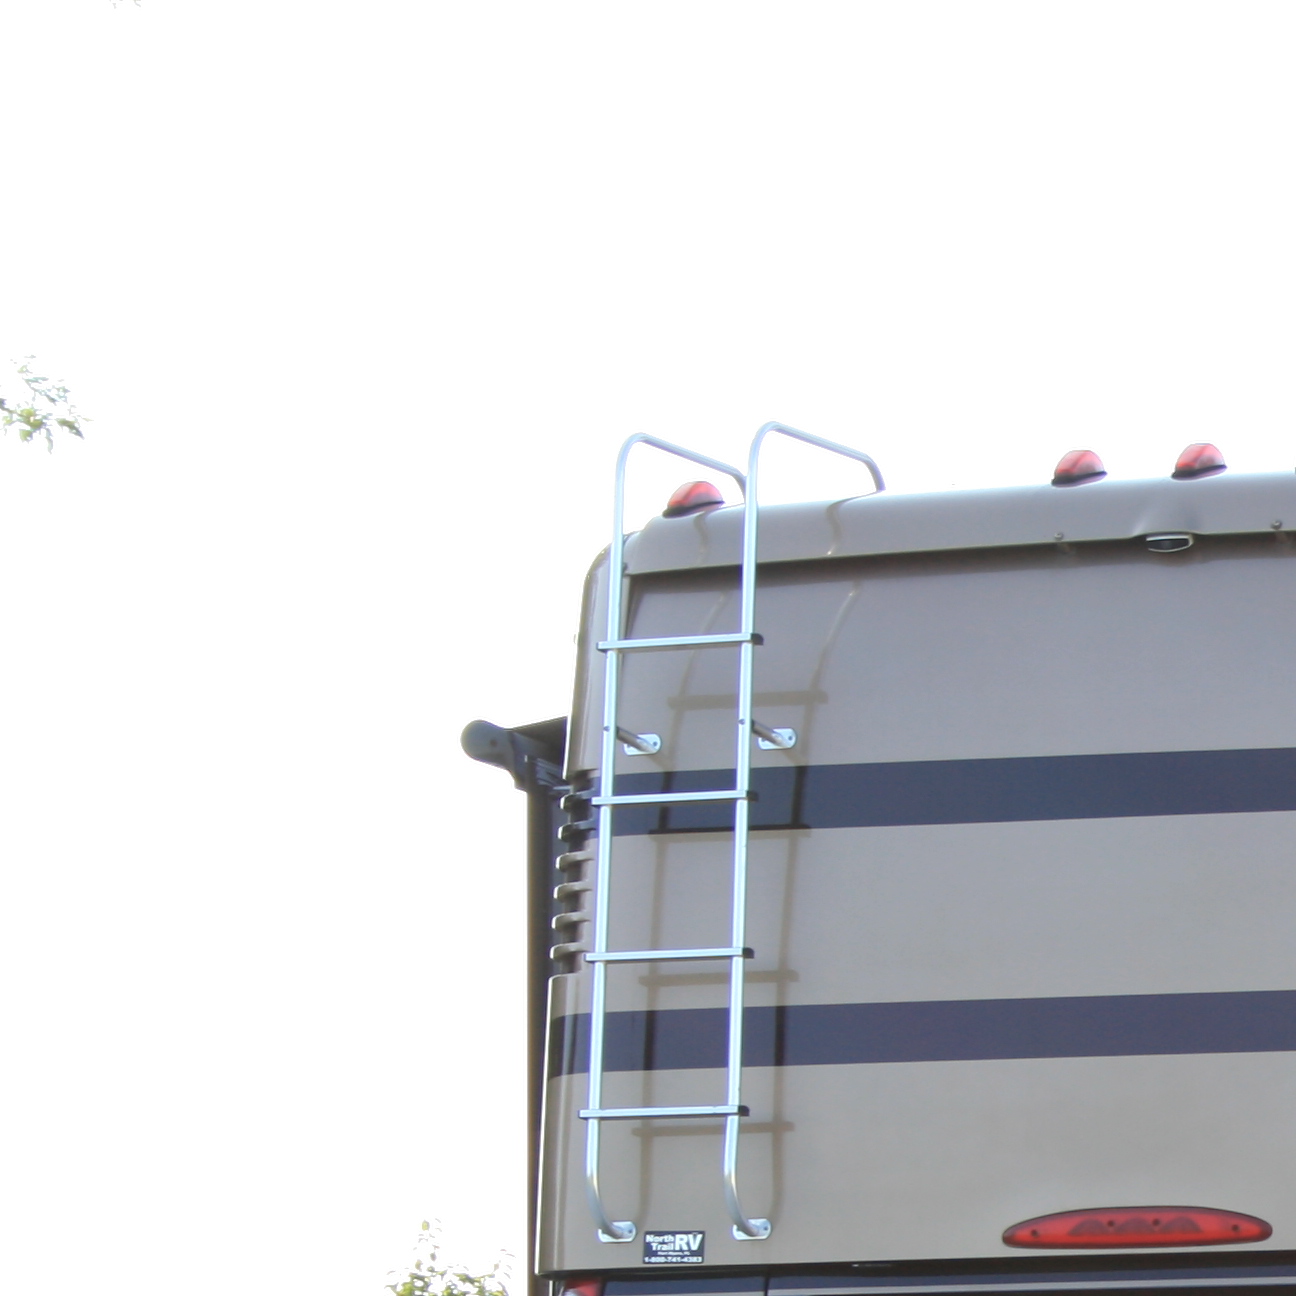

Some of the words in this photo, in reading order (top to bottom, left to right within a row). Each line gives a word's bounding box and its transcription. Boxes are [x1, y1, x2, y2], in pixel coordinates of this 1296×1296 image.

[645, 1234, 674, 1243] North
[674, 1233, 702, 1250] RV
[651, 1242, 674, 1251] Trail
